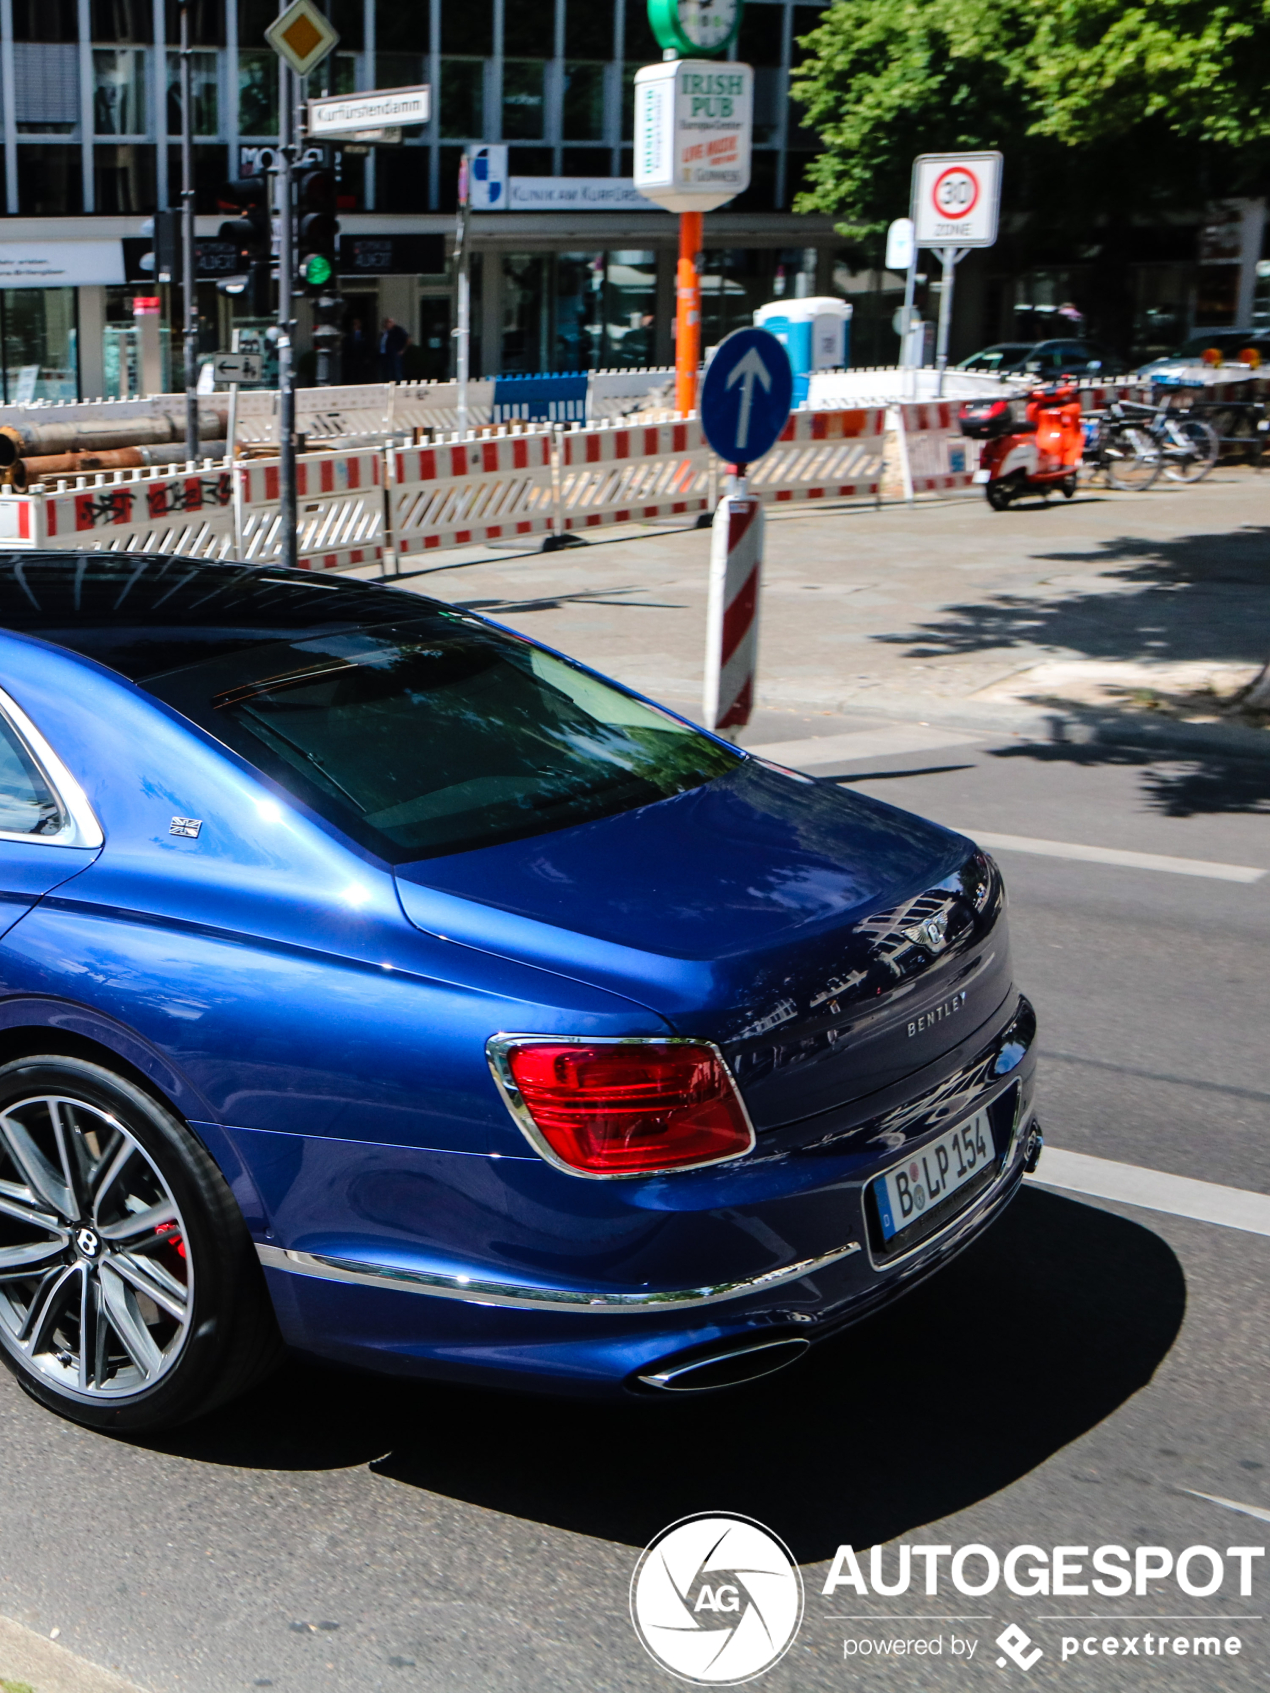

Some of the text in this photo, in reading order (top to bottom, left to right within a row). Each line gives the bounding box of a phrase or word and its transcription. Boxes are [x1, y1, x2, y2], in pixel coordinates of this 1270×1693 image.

[681, 74, 744, 95] IRISH
[316, 97, 422, 122] Kurfürstendamm
[691, 96, 734, 118] PUB
[941, 180, 973, 205] 30
[934, 222, 973, 238] ZONE
[907, 990, 967, 1038] BENTLEY
